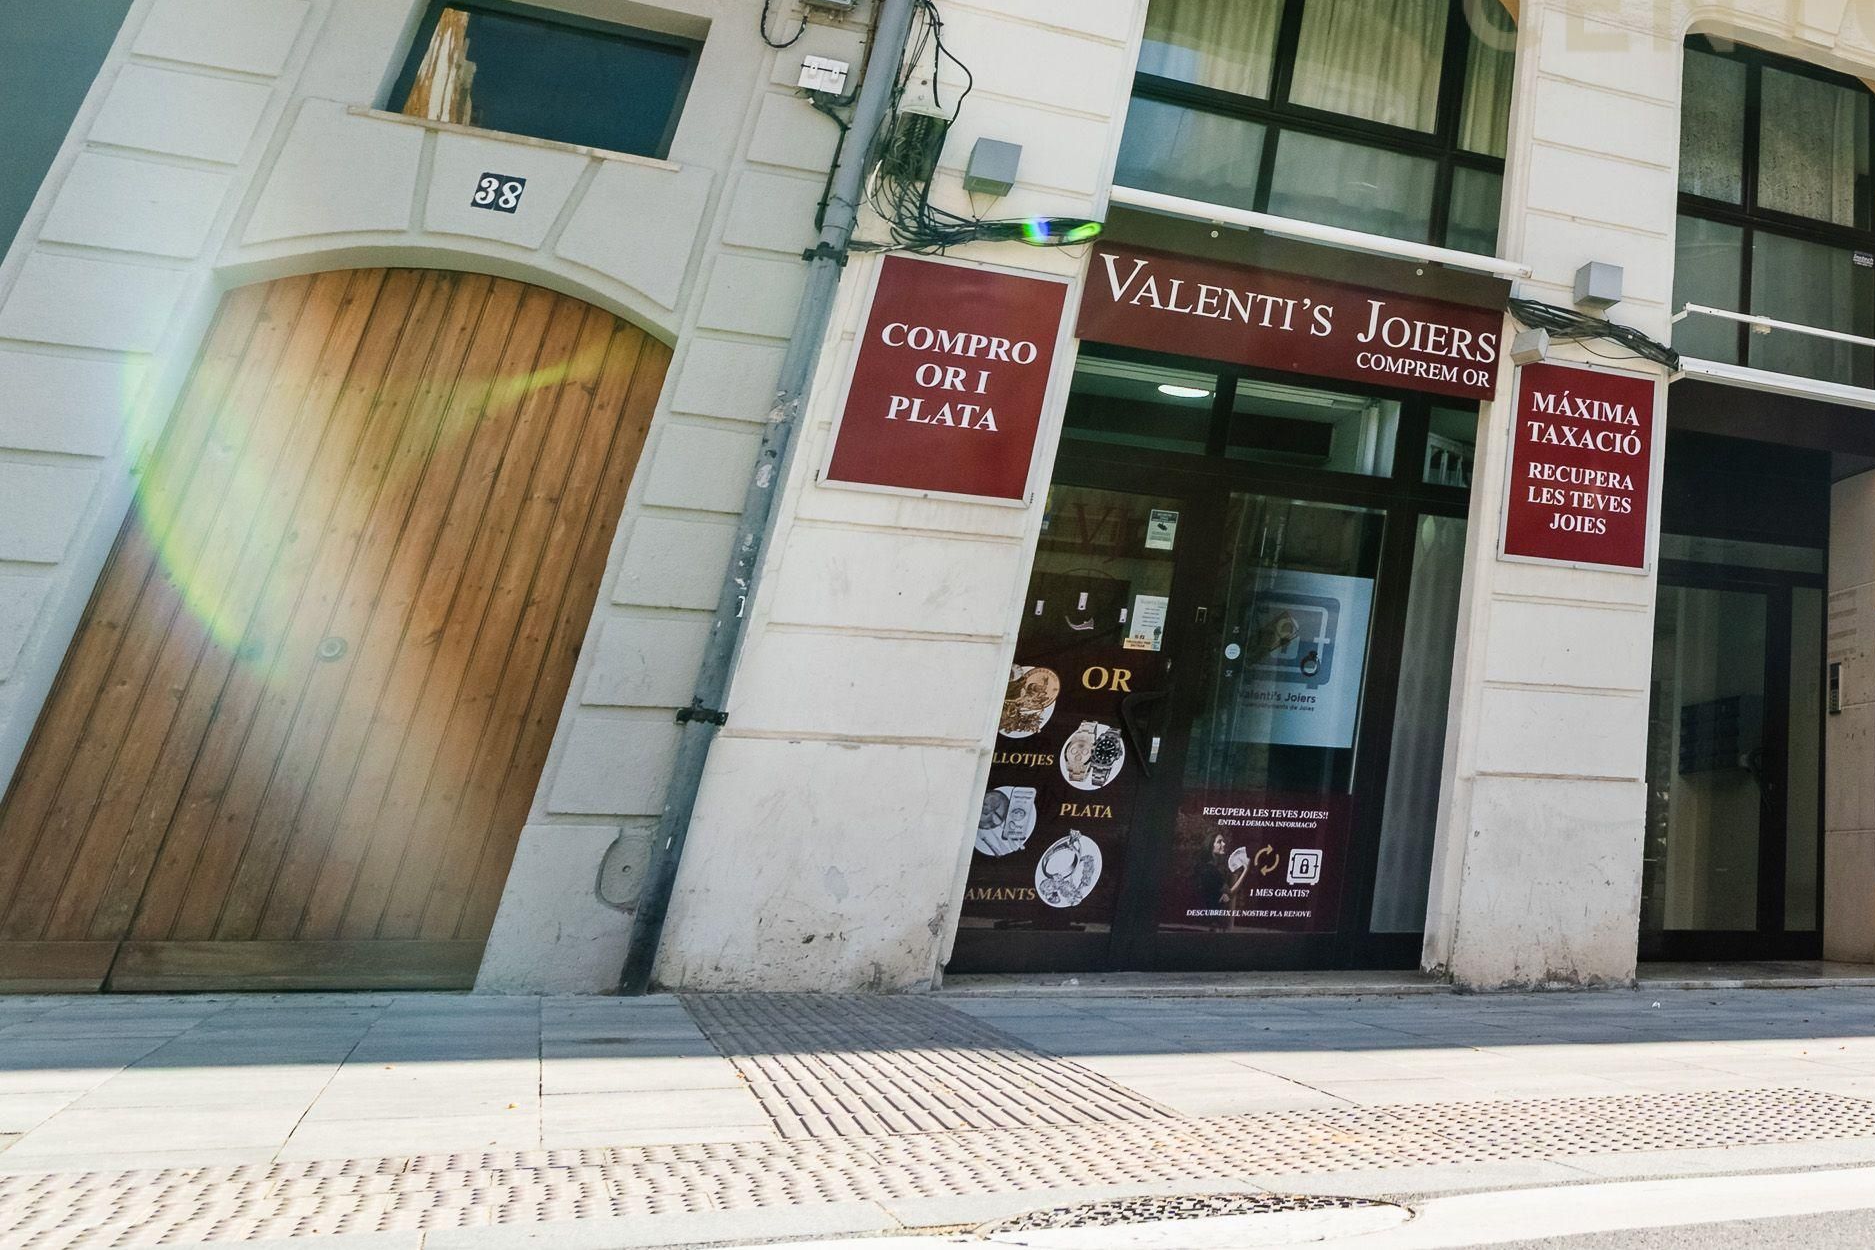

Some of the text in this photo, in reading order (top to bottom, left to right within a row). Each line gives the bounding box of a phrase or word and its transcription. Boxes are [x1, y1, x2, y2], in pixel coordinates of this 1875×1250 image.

[474, 177, 523, 209] 38
[881, 322, 1038, 365] COMPRO
[1356, 299, 1497, 364] JOIERS
[915, 363, 992, 395] OR I
[1356, 352, 1491, 389] COMPREM OR
[885, 395, 999, 432] PLATA
[1532, 390, 1640, 427] MÁXIMA
[1527, 420, 1642, 456] TAXACIÓ
[1527, 461, 1634, 491] RECUPERA
[1527, 485, 1632, 514] LES TEVES
[1549, 513, 1606, 535] JOIES
[1082, 666, 1132, 692] OR
[1285, 692, 1317, 704] Joiers
[1060, 803, 1113, 819] PLATA
[1203, 806, 1329, 820] RECUPERA LES TEVES JOIES!!
[1217, 819, 1241, 827] ENTRA
[1245, 820, 1275, 828] DEMANA
[1275, 820, 1317, 829] INFORMACIÓ
[1255, 888, 1274, 897] MES
[1274, 889, 1310, 898] GRATIS?
[1186, 909, 1233, 917] DESCUBREIX
